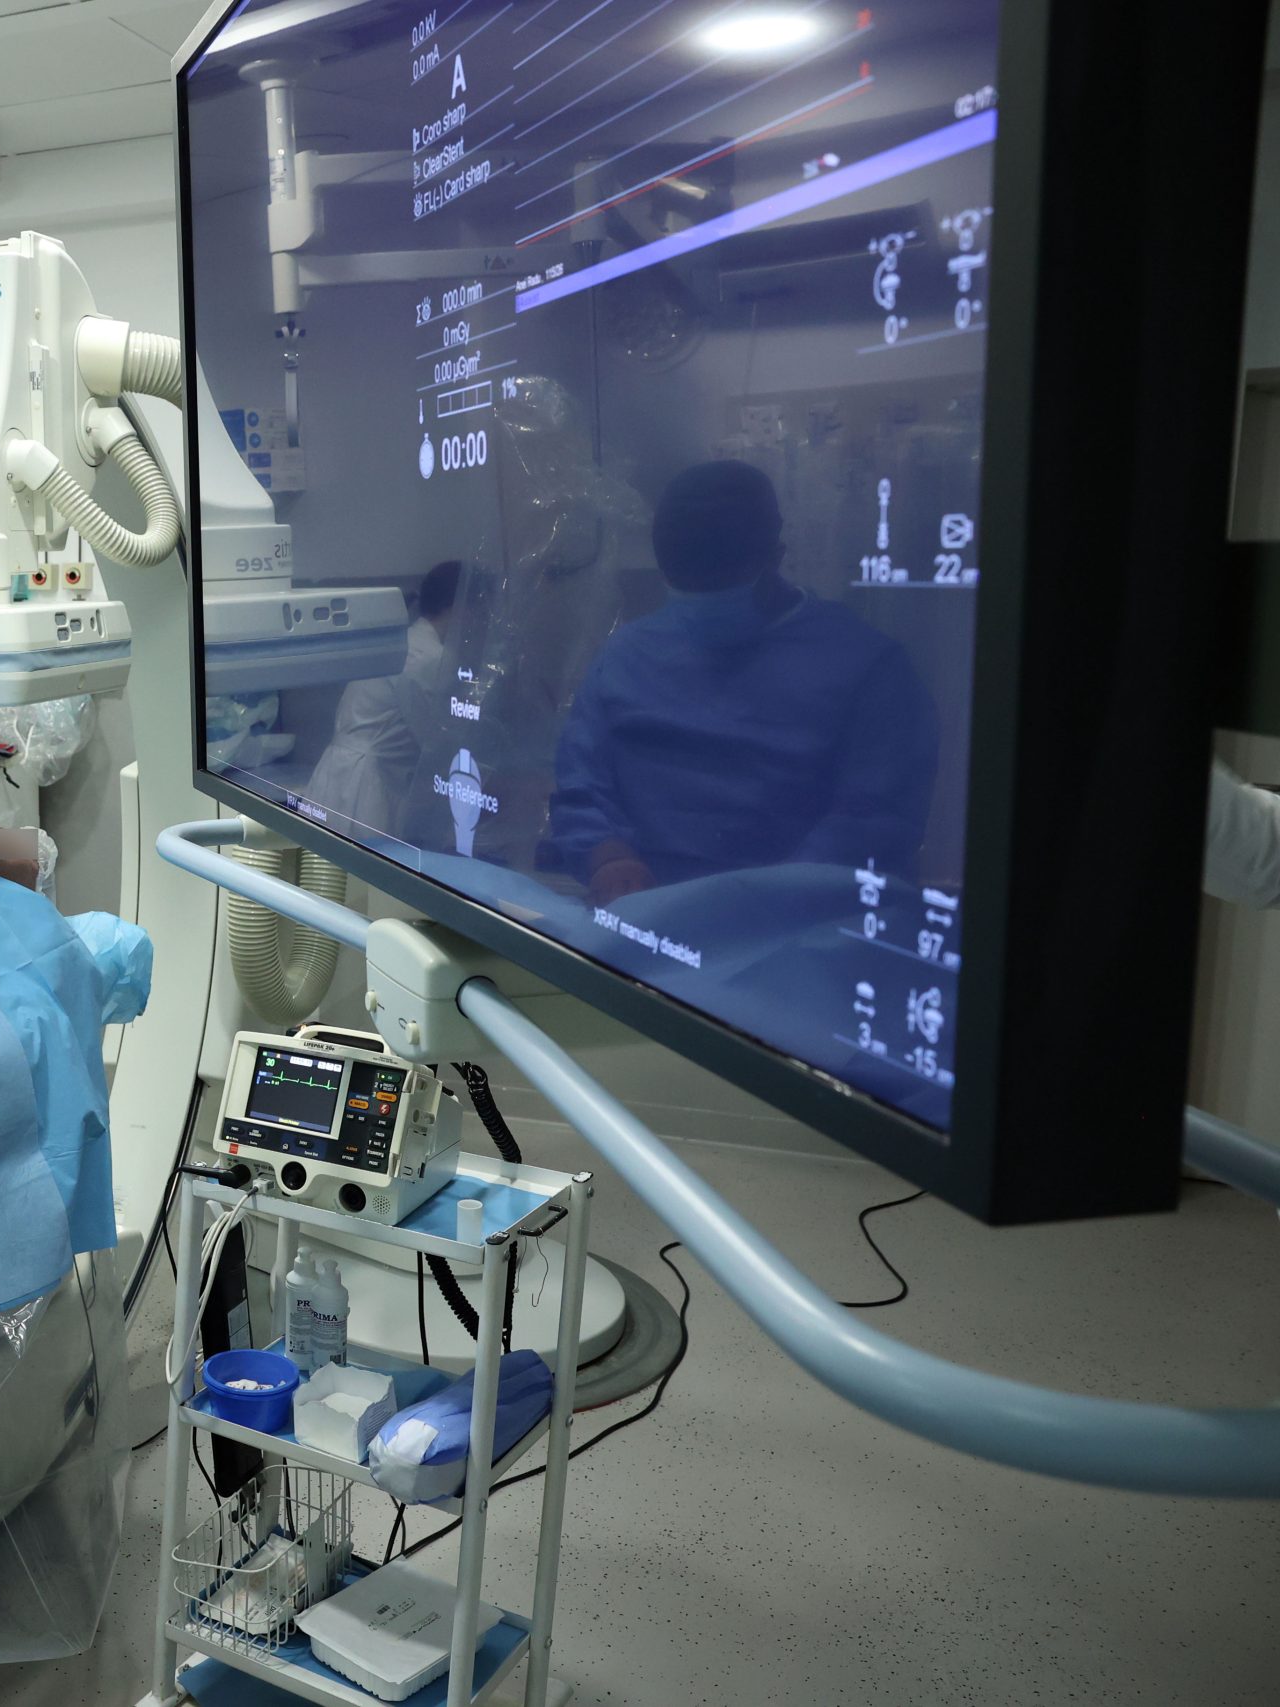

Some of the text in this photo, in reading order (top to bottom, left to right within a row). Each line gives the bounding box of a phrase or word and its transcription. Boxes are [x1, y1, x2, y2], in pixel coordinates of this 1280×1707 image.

[451, 54, 467, 99] A
[422, 102, 467, 145] Coro sharp
[422, 136, 465, 178] ClearStent
[444, 171, 465, 200] Card
[465, 160, 491, 188] sharp
[466, 280, 483, 306] min
[443, 321, 470, 347] 0 mGy
[442, 430, 487, 471] 00:00
[450, 696, 480, 721] Review
[433, 774, 499, 813] Store Reference
[593, 906, 620, 932] XRAY
[304, 1041, 324, 1050] LIFEPAK
